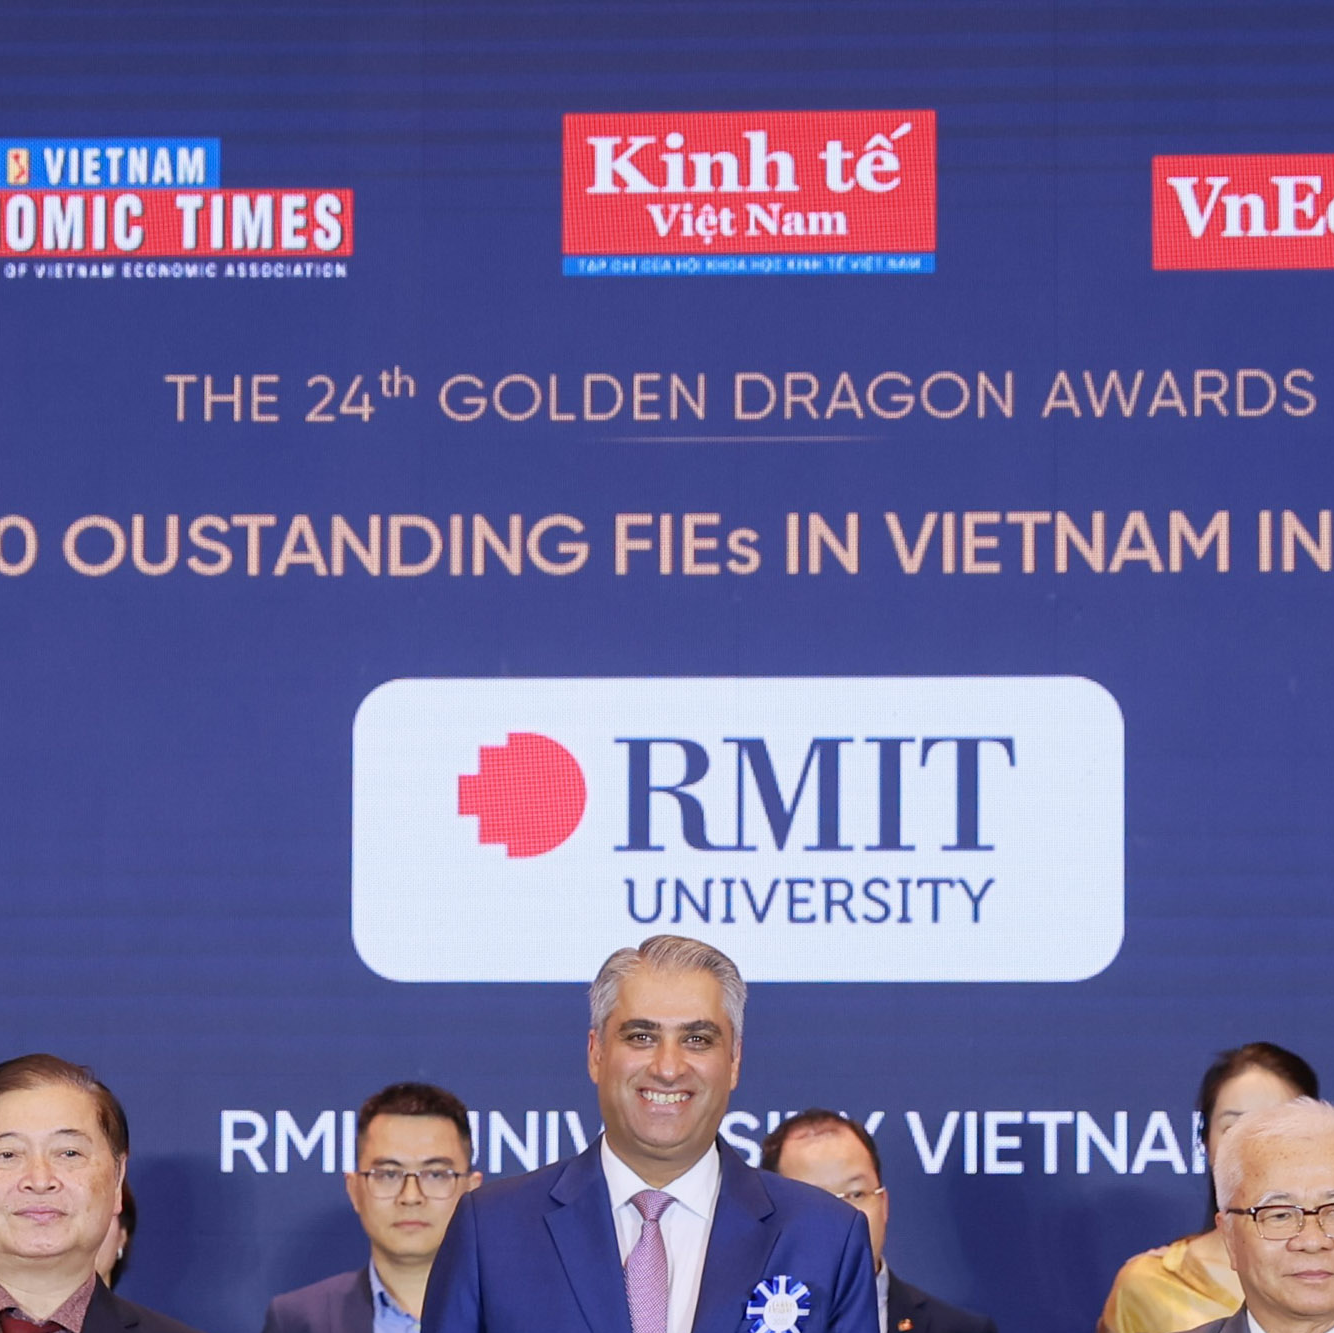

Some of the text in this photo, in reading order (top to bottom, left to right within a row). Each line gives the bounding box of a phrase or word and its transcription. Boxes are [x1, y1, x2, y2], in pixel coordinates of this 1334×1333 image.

[44, 146, 206, 186] VIETNAM
[586, 122, 912, 194] Kinh tế
[175, 193, 342, 251] TIMES
[646, 202, 847, 245] Việt Nam
[3, 263, 27, 279] OF
[34, 262, 115, 279] VIETNAM
[122, 262, 217, 278] ECONOMIC
[224, 262, 347, 278] ASSOCIATION
[164, 366, 1317, 422] THE 24th GOLDEN DRAGON AWARDS
[62, 513, 589, 577] OUSTANDING
[614, 512, 761, 576] FIEs
[786, 512, 859, 575] IN
[884, 510, 1230, 574] VIETNAM
[1258, 509, 1332, 573] IN
[613, 736, 1016, 852] RMIT
[625, 877, 994, 924] UNIVERSITY
[220, 1110, 357, 1174] RMI
